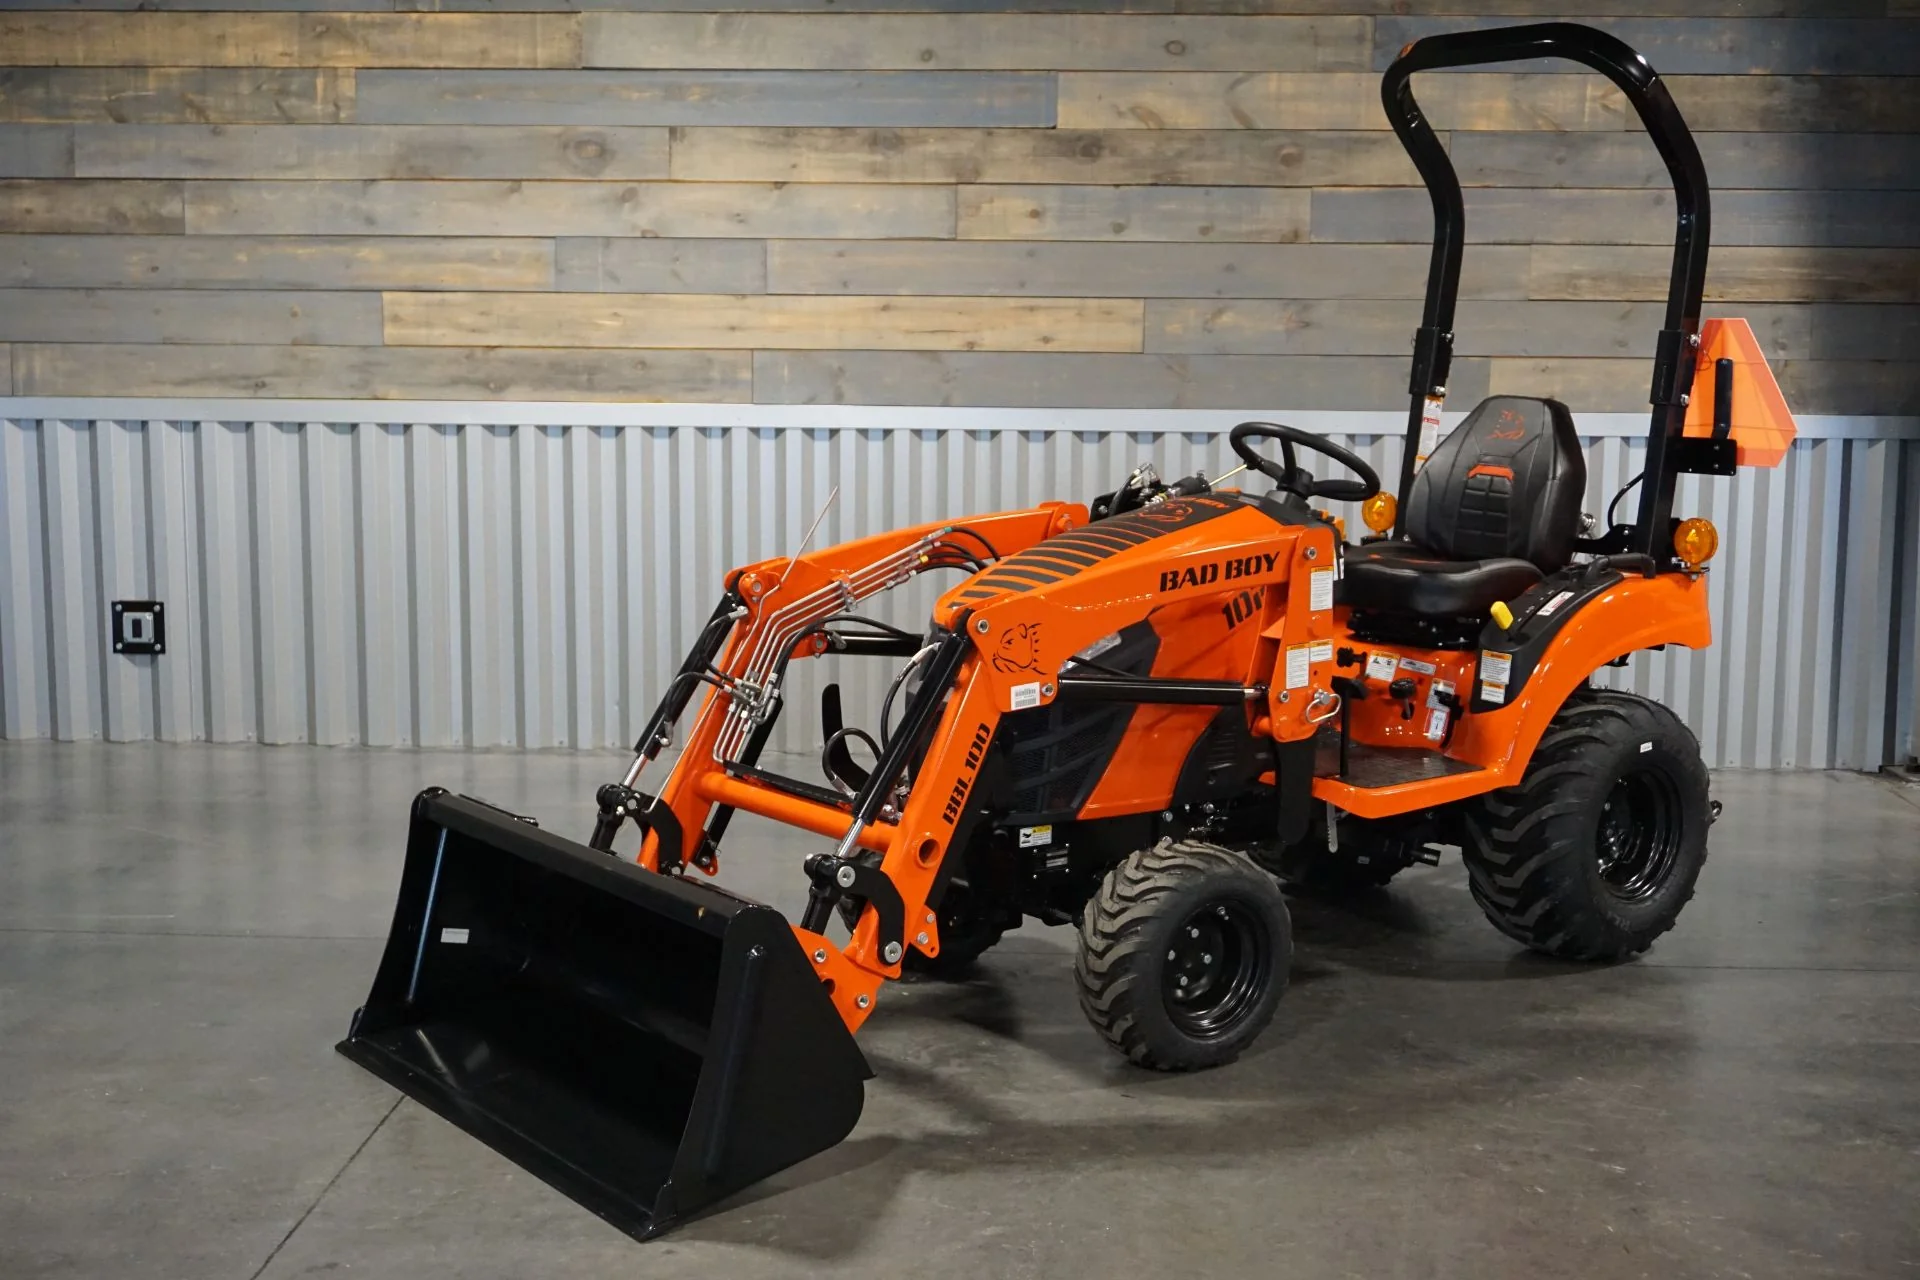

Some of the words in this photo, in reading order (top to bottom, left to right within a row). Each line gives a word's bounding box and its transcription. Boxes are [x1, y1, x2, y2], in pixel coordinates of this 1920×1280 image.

[1160, 563, 1218, 592] BAD
[1225, 551, 1280, 580] BOY
[942, 776, 972, 825] BBL
[965, 723, 991, 771] 100
